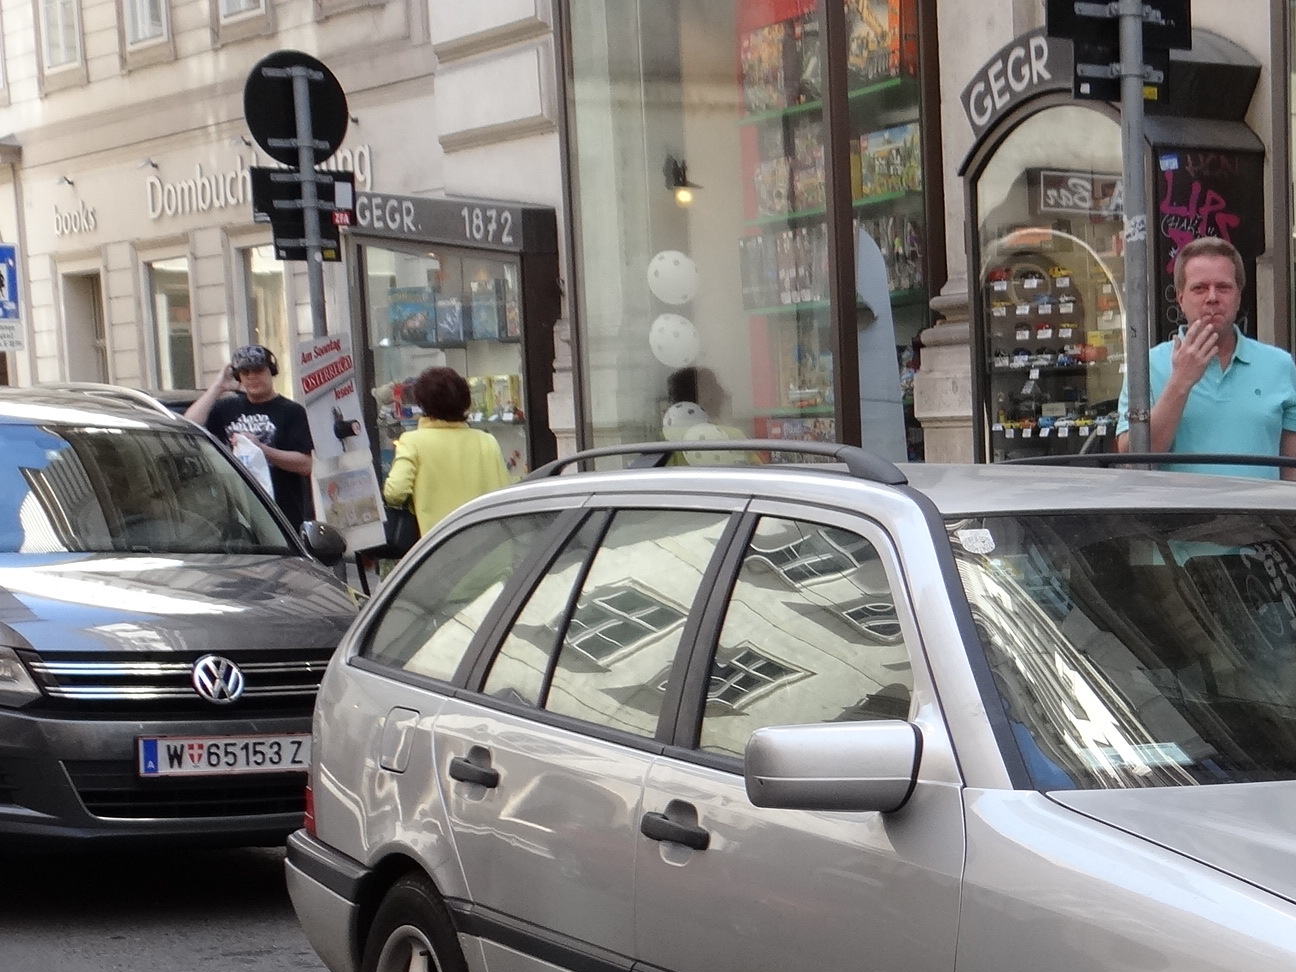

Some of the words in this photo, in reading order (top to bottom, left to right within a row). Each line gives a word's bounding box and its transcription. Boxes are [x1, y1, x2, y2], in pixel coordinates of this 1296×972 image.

[53, 201, 97, 236] books
[461, 206, 513, 244] 1872
[206, 741, 283, 768] 65153
